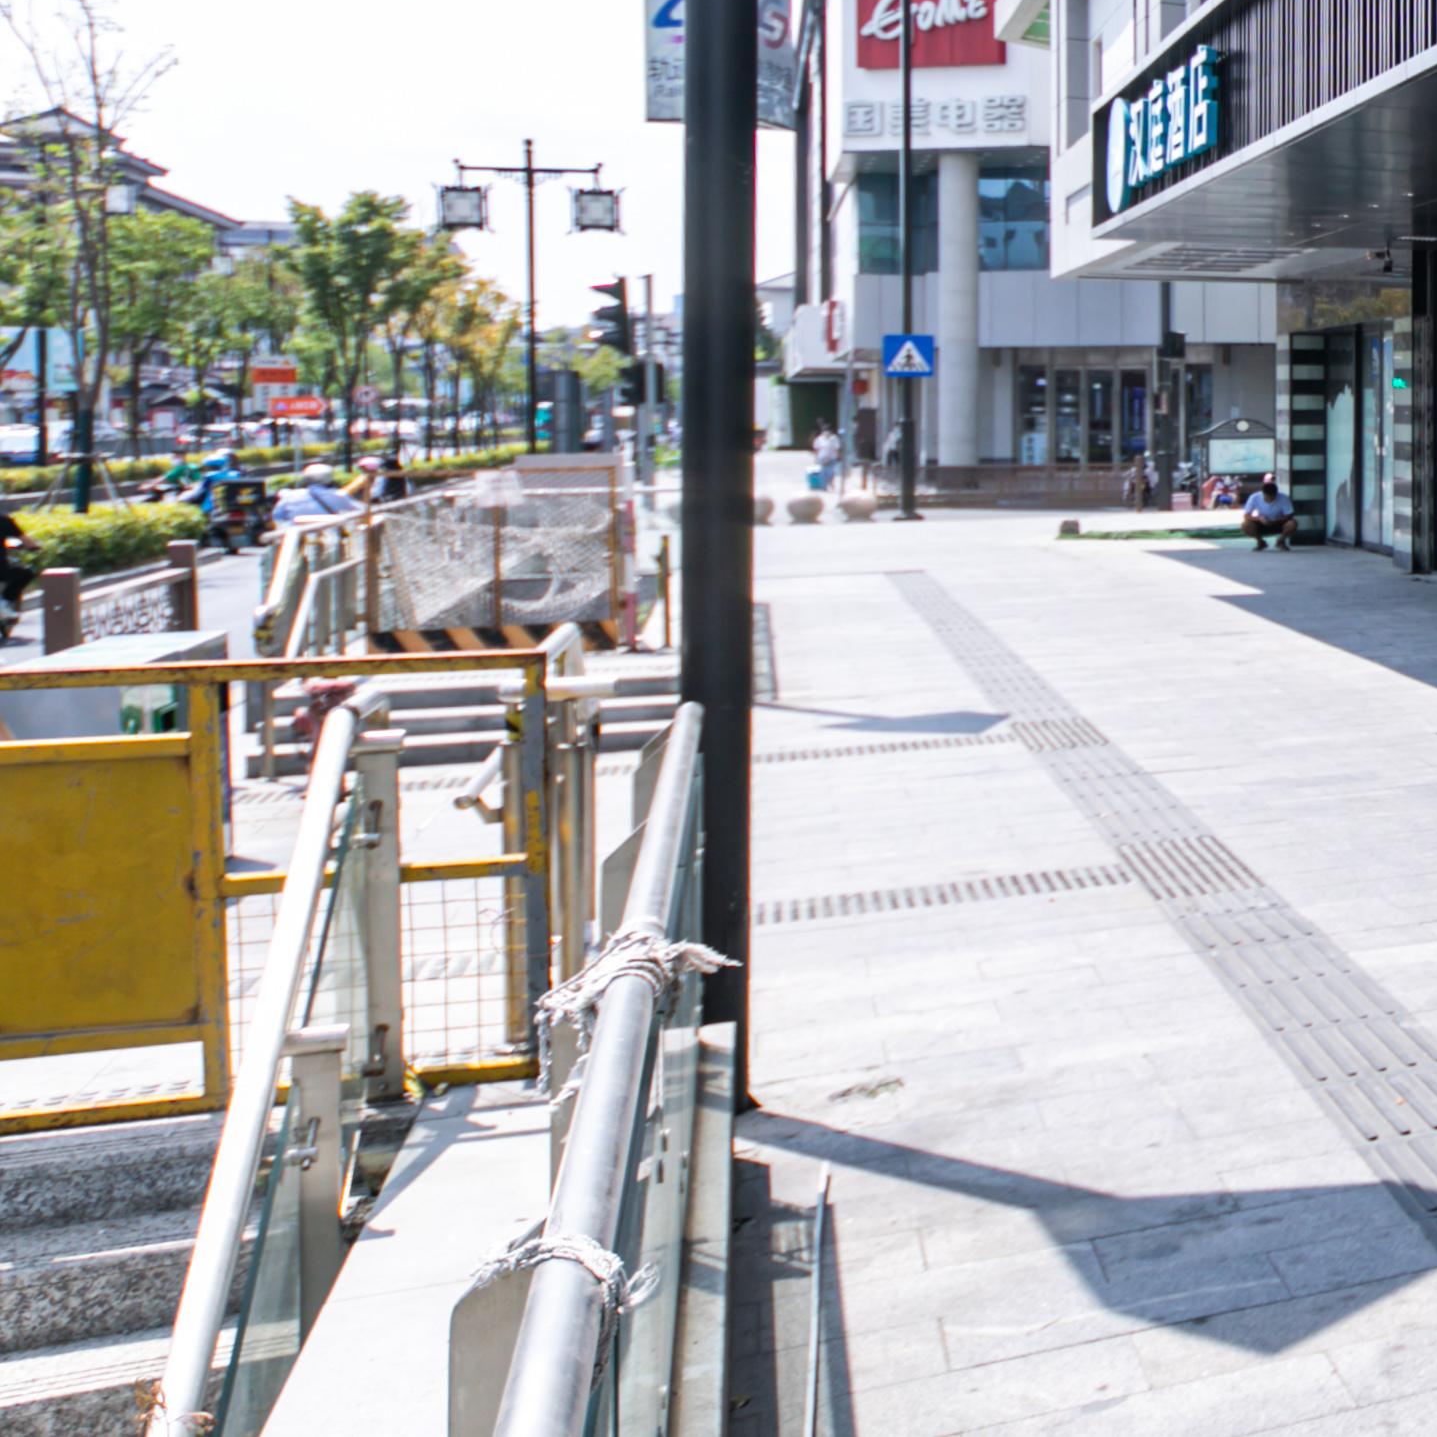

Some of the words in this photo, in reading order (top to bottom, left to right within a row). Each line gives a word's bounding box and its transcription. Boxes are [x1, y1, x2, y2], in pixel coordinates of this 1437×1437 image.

[843, 95, 1026, 138] 国美电器
[1128, 44, 1217, 187] 汉庭酒店
